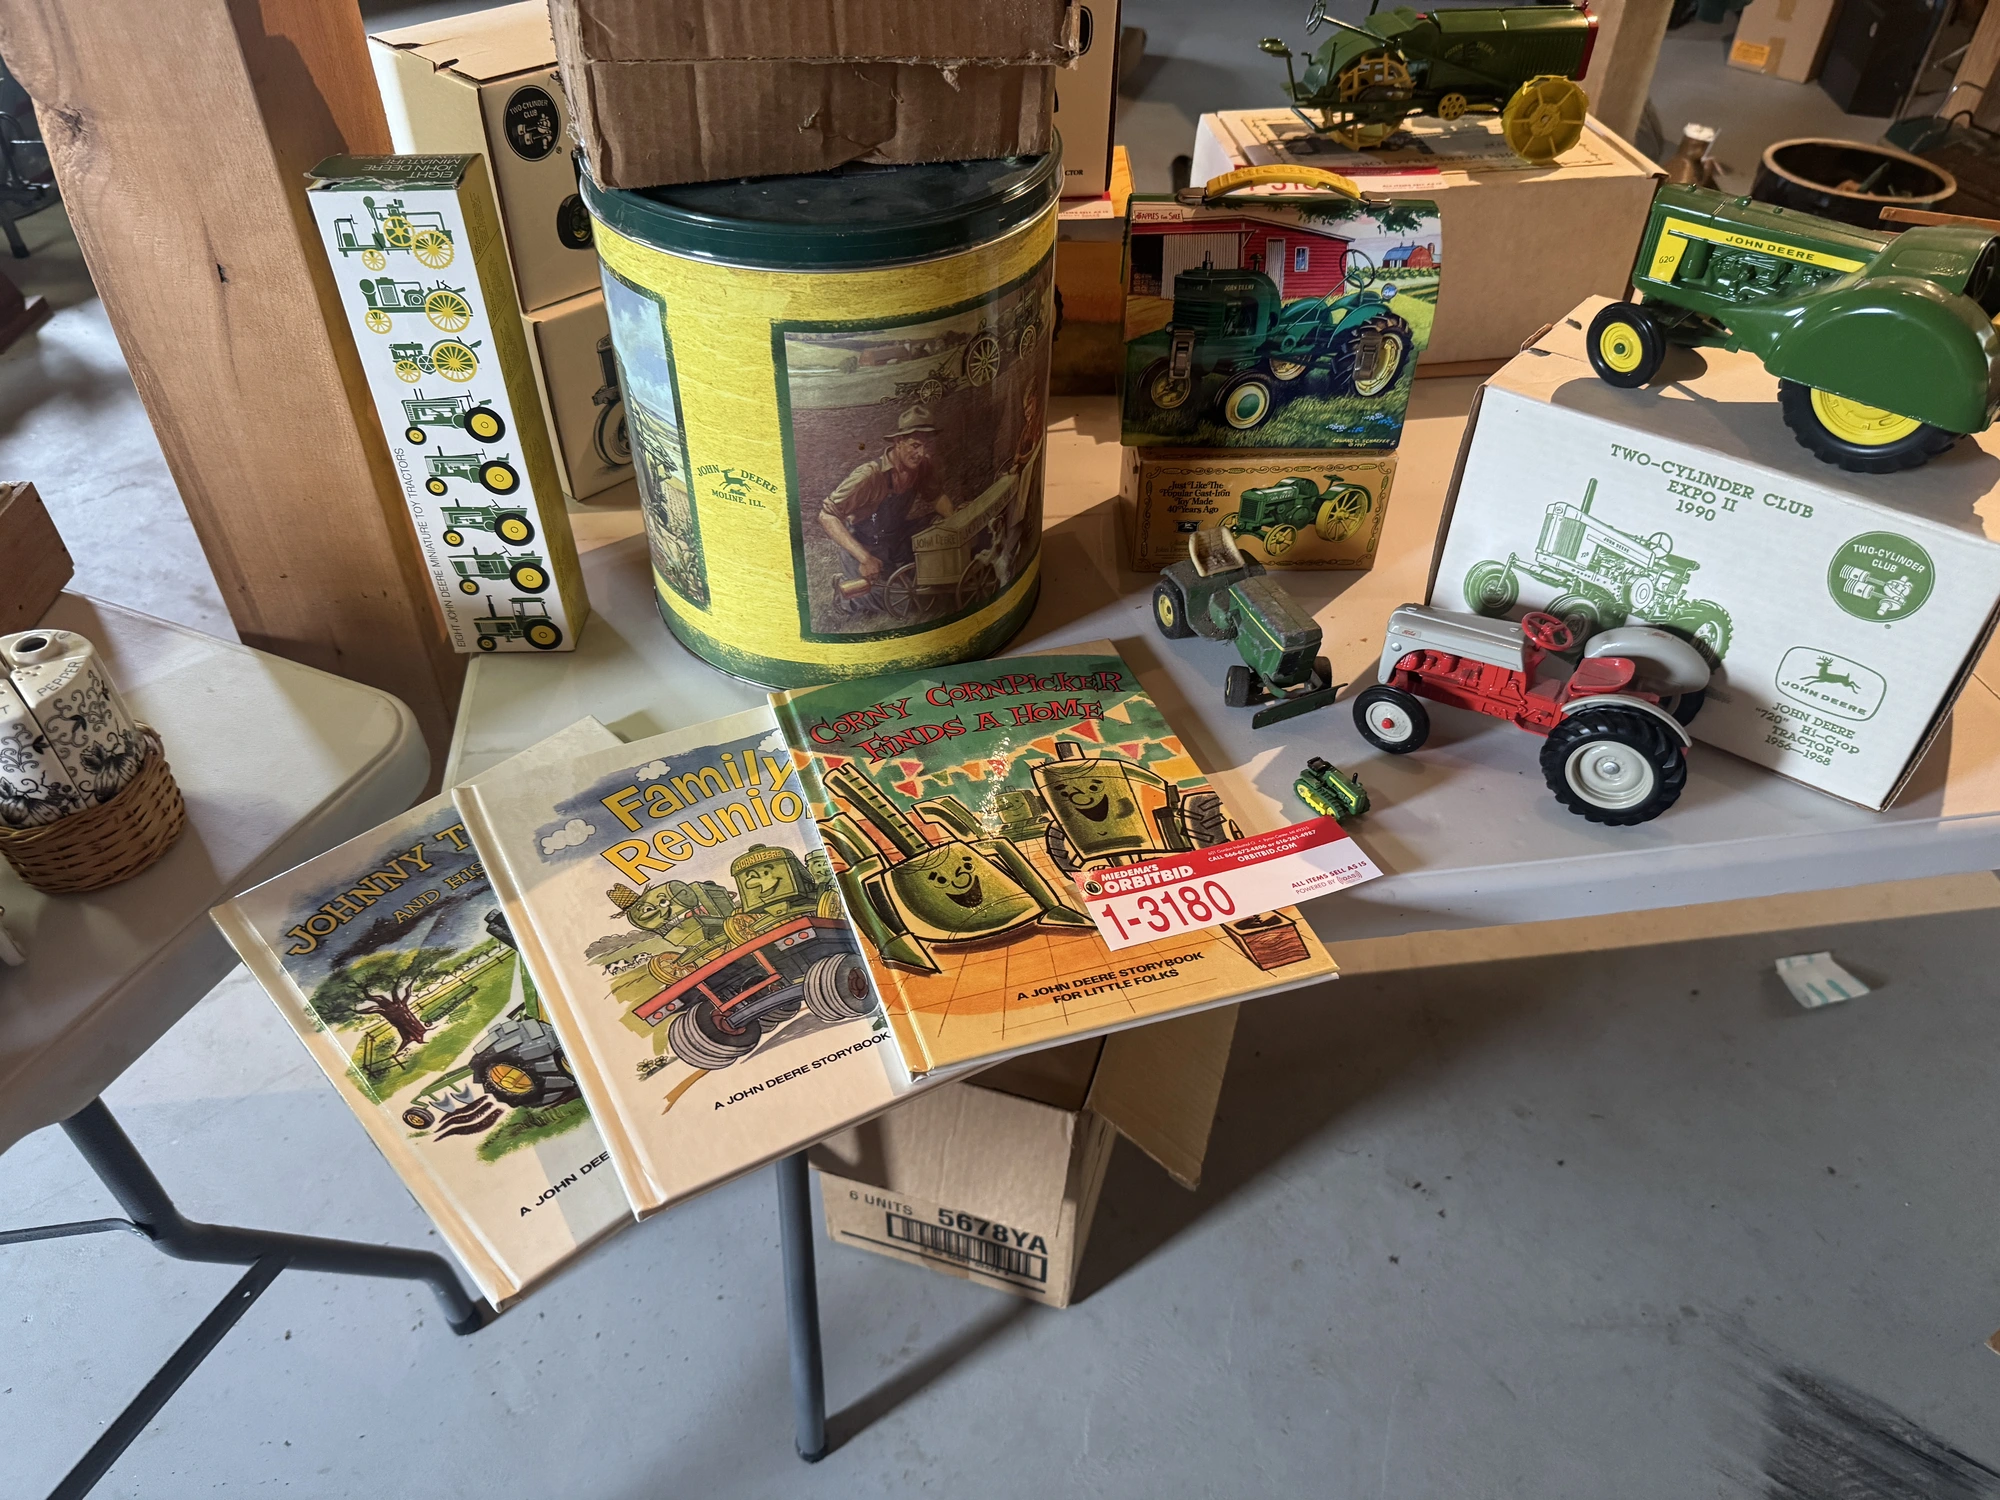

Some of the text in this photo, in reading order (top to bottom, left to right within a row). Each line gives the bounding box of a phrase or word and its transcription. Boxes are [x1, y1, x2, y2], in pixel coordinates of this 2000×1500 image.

[523, 109, 538, 119] CLUB
[362, 164, 458, 172] JOHN DEERE
[406, 170, 454, 179] EIGHT
[1658, 255, 1674, 264] 620
[1725, 235, 1815, 261] JOHN DEERE
[697, 464, 778, 494] JOHN DEERE
[1160, 488, 1230, 498] Popular Cast-Iron
[1169, 481, 1223, 490] Just Like The
[1611, 443, 1815, 519] TWO-CYLINDER CLUB
[749, 499, 766, 509] ILL.
[1167, 505, 1219, 514] 40 Years Ago
[1175, 497, 1188, 507] Toy
[1667, 479, 1739, 513] EXPO II
[1675, 499, 1717, 522] 1990
[394, 447, 466, 648] EIGHT JOHN DEERE MINIATURE TOY TRACTORS
[1852, 544, 1925, 574] TWO-CYLINDER
[1871, 558, 1898, 573] CLUB
[36, 661, 84, 697] PEPPER
[1781, 680, 1867, 716] JOHN DEERE
[971, 711, 1003, 733] A
[1772, 702, 1856, 740] JOHN DEERE
[1772, 725, 1835, 756] TRACTOR
[1800, 724, 1860, 755] Hi-Crop
[600, 749, 795, 832] Family
[600, 787, 806, 886] Reunio
[736, 850, 782, 871] JOHN DEERE
[1208, 854, 1224, 862] CALL
[1237, 842, 1298, 862] ORBITBID.COM
[1101, 863, 1159, 882] MIEDEMA'S
[1103, 865, 1195, 894] ORBITBID
[1291, 860, 1367, 889] ALL ITEMS SELL AS IS
[1295, 882, 1327, 895] POWERED
[1327, 878, 1336, 886] BY
[285, 842, 433, 956] JOHNNY
[392, 860, 485, 924] AND HIS
[1101, 880, 1236, 941] 1-3180
[1016, 951, 1205, 1001] A JOHN DEERE STORYBOOK
[1052, 969, 1180, 1004] FOR LITTLE FOLKS
[714, 1031, 892, 1111] A JOHN DEERE STORYBOOK
[520, 1150, 610, 1217] A JOHN DEE
[849, 1190, 914, 1216] 6 UNITS
[938, 1207, 1049, 1255] 5678YA
